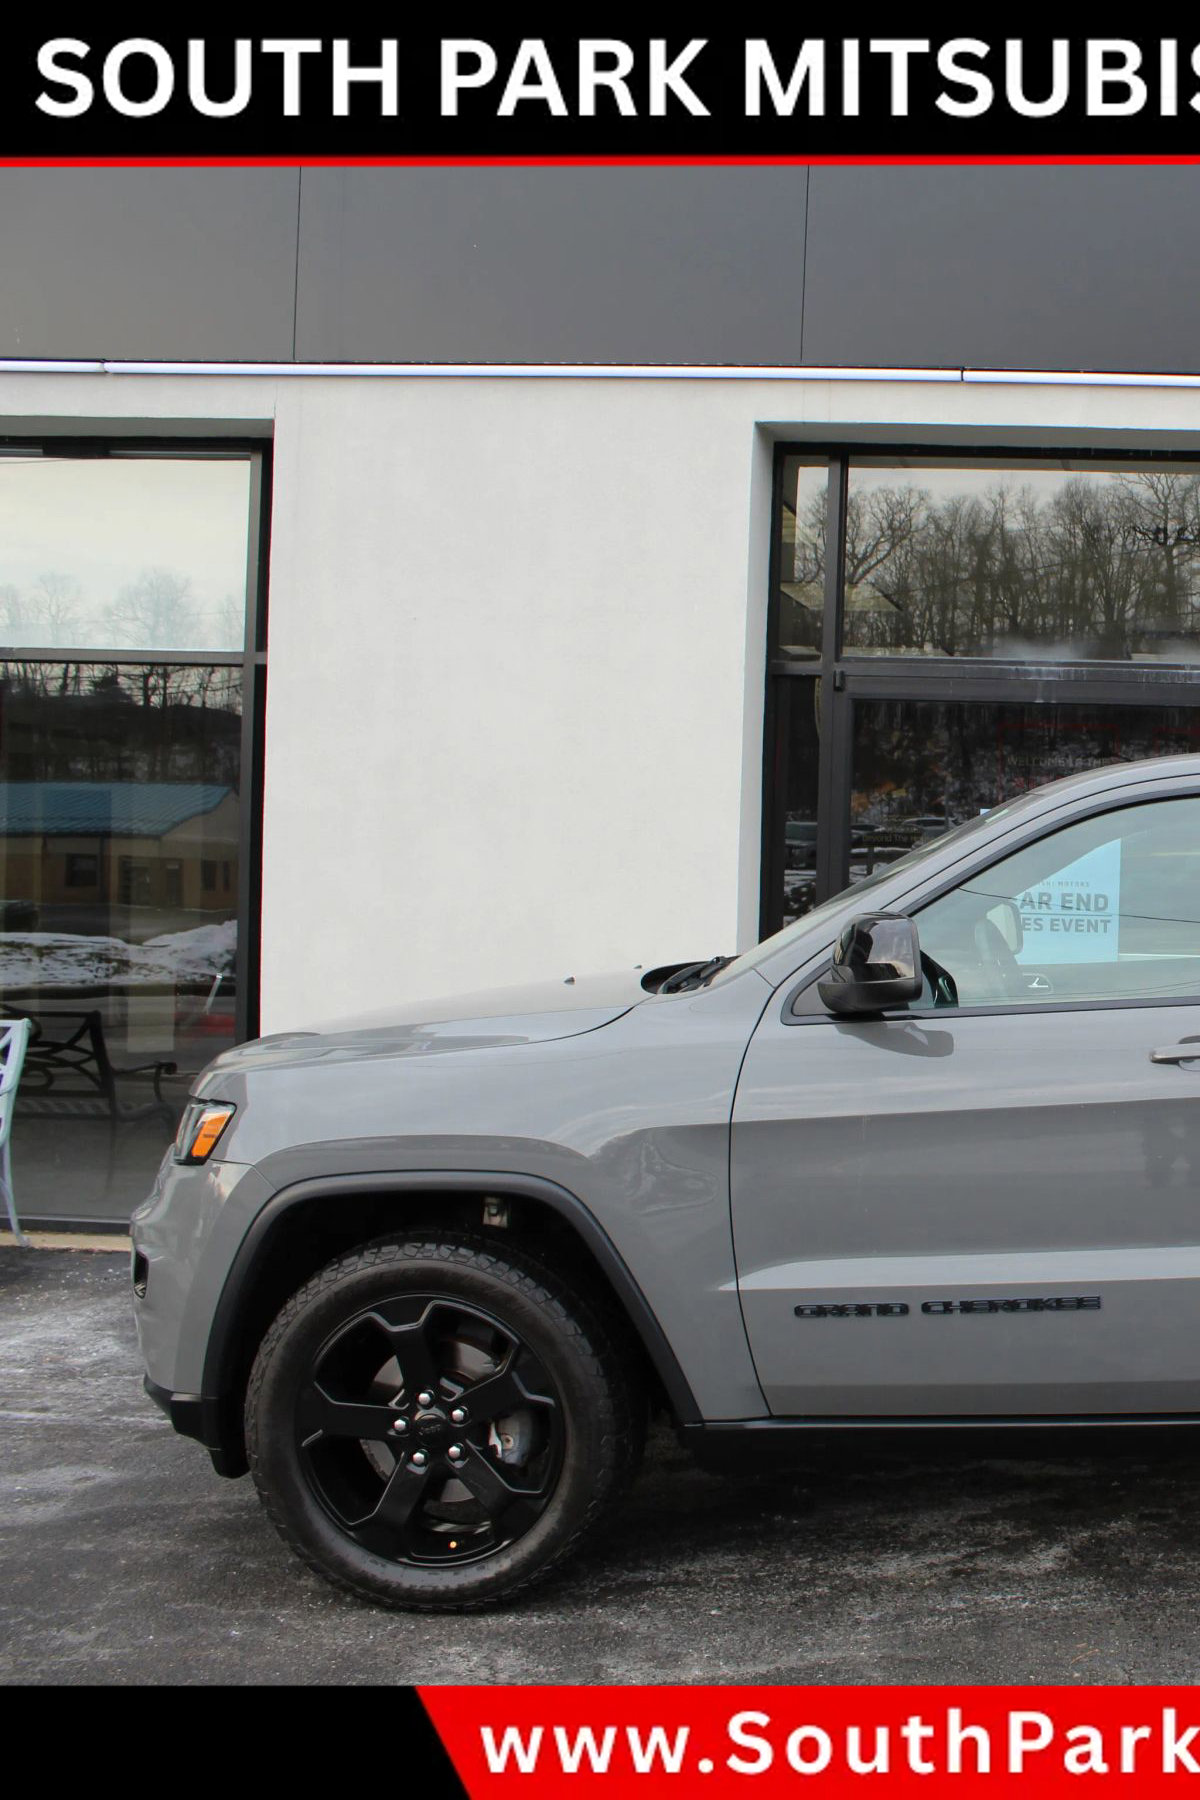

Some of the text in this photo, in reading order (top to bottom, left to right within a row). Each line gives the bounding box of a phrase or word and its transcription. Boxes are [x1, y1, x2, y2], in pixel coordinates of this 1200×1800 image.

[1060, 892, 1109, 912] END
[1049, 918, 1111, 933] EVENT
[794, 1296, 1101, 1318] GRAND CHEROKEE
